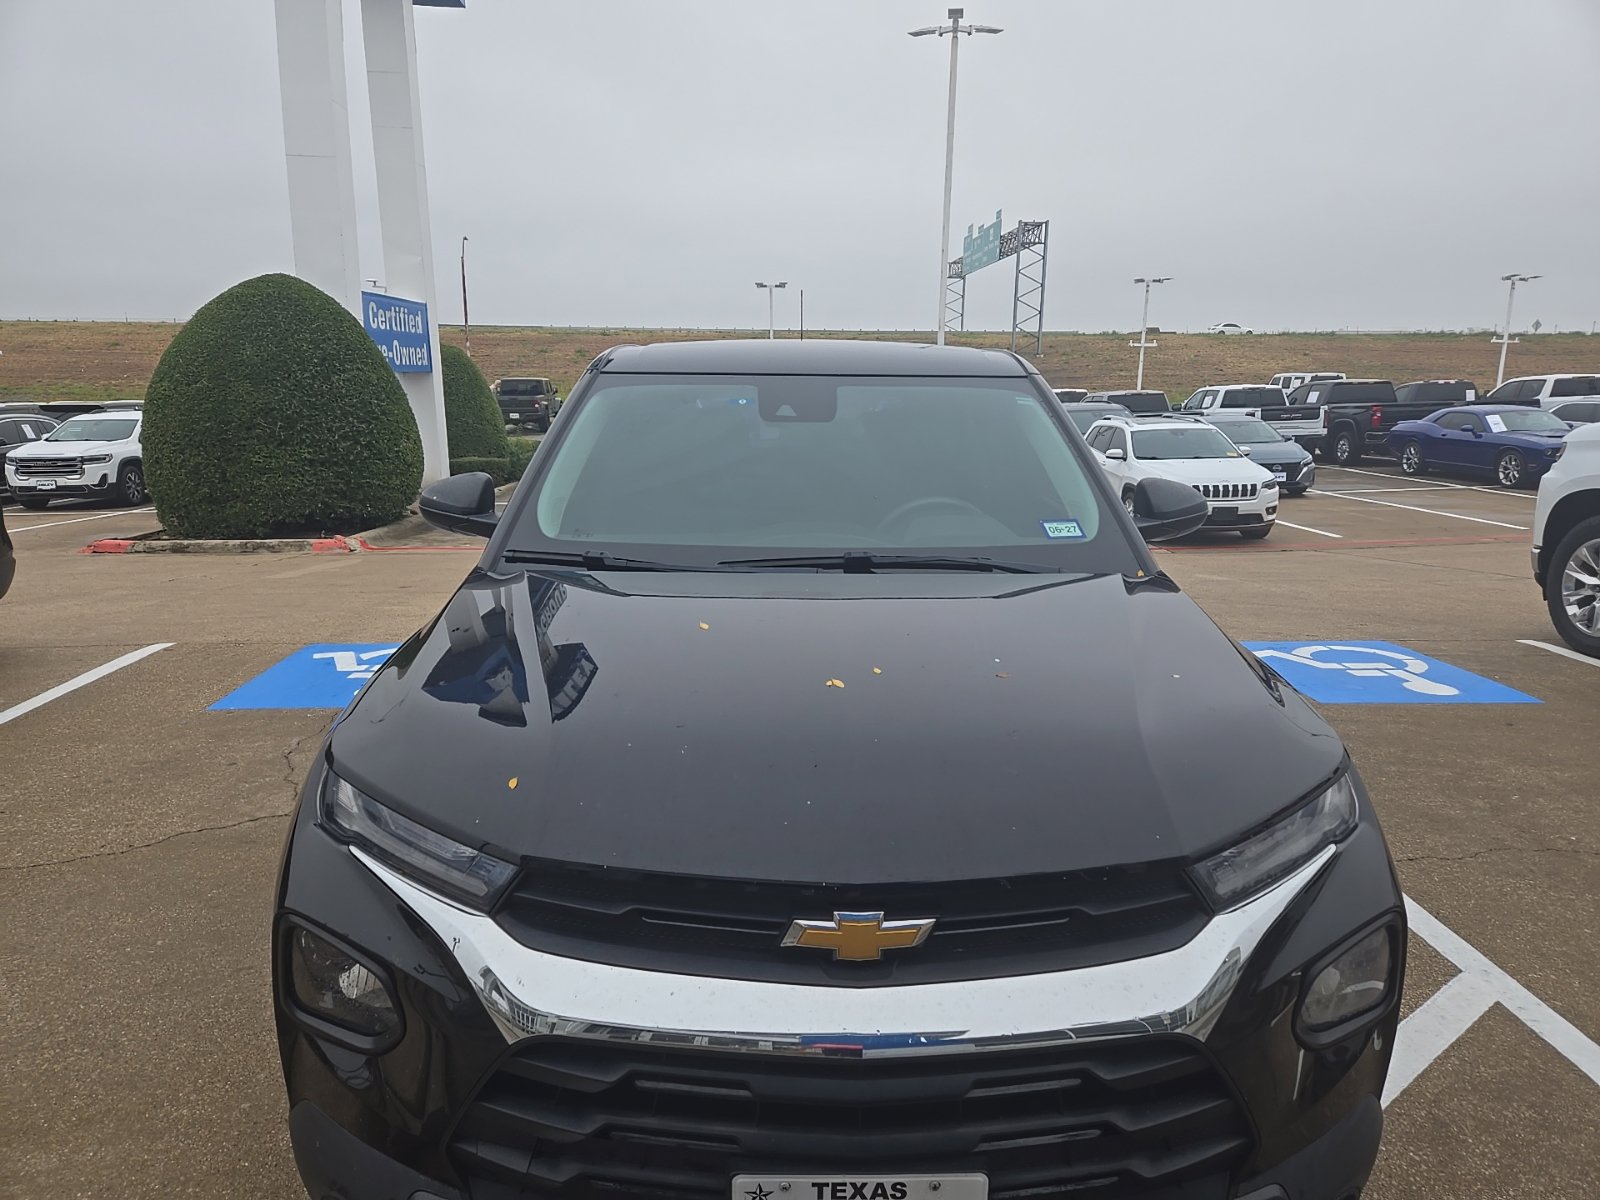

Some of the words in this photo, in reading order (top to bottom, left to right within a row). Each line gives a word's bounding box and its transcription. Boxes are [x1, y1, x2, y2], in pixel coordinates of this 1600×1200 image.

[369, 302, 423, 334] Certified
[376, 339, 428, 366] e-Owned
[811, 1182, 908, 1200] TEXAS
